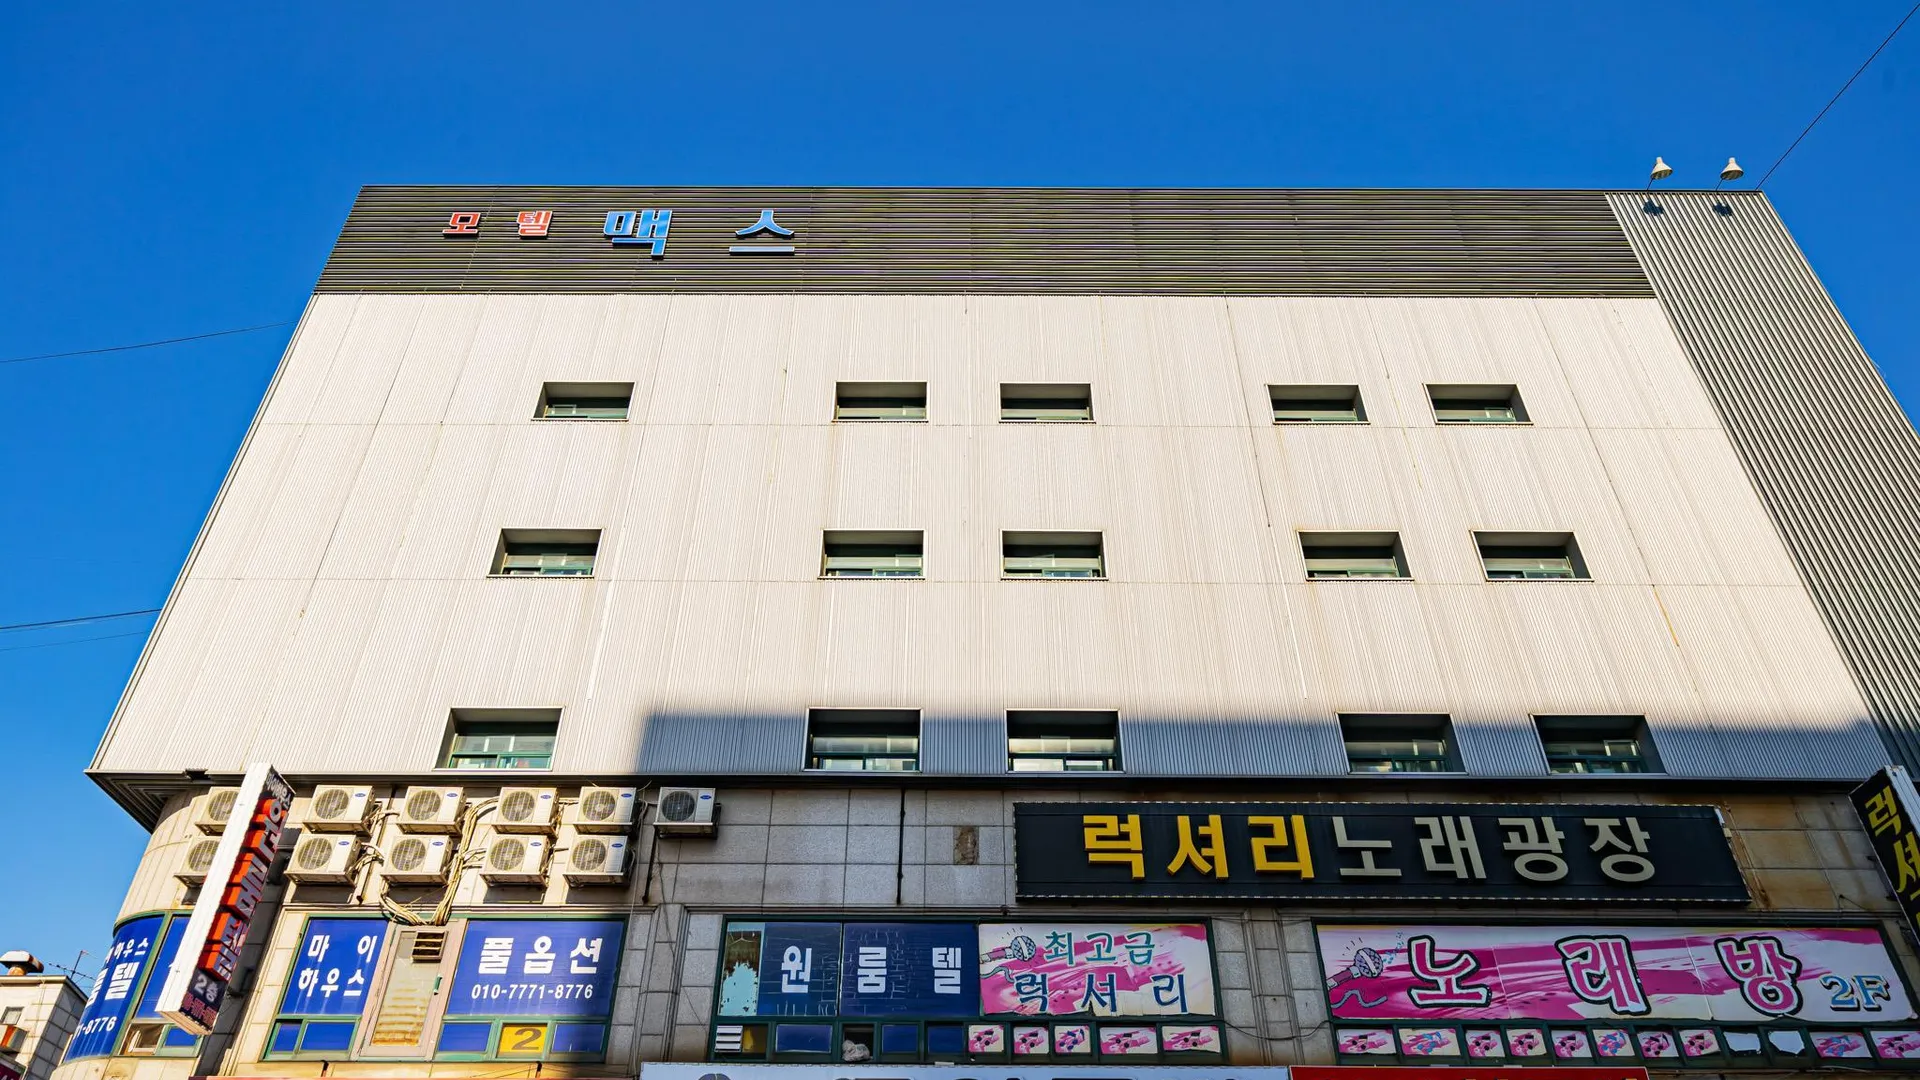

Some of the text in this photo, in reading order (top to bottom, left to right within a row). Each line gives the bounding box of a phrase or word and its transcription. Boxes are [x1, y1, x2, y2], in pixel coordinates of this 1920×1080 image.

[442, 209, 796, 258] 모텔 맥스
[211, 799, 289, 982] 원룸텔
[478, 935, 603, 975] 풀옵션
[1044, 930, 1156, 966] 최고급
[194, 975, 219, 1003] 2층
[298, 967, 365, 998] 하우스
[780, 944, 962, 995] 원룸텔
[1406, 934, 1888, 1017] 노래방 2F
[471, 983, 594, 1000] 010-7771-8776
[1013, 973, 1188, 1014] 럭셔리
[511, 1027, 542, 1050] 2
